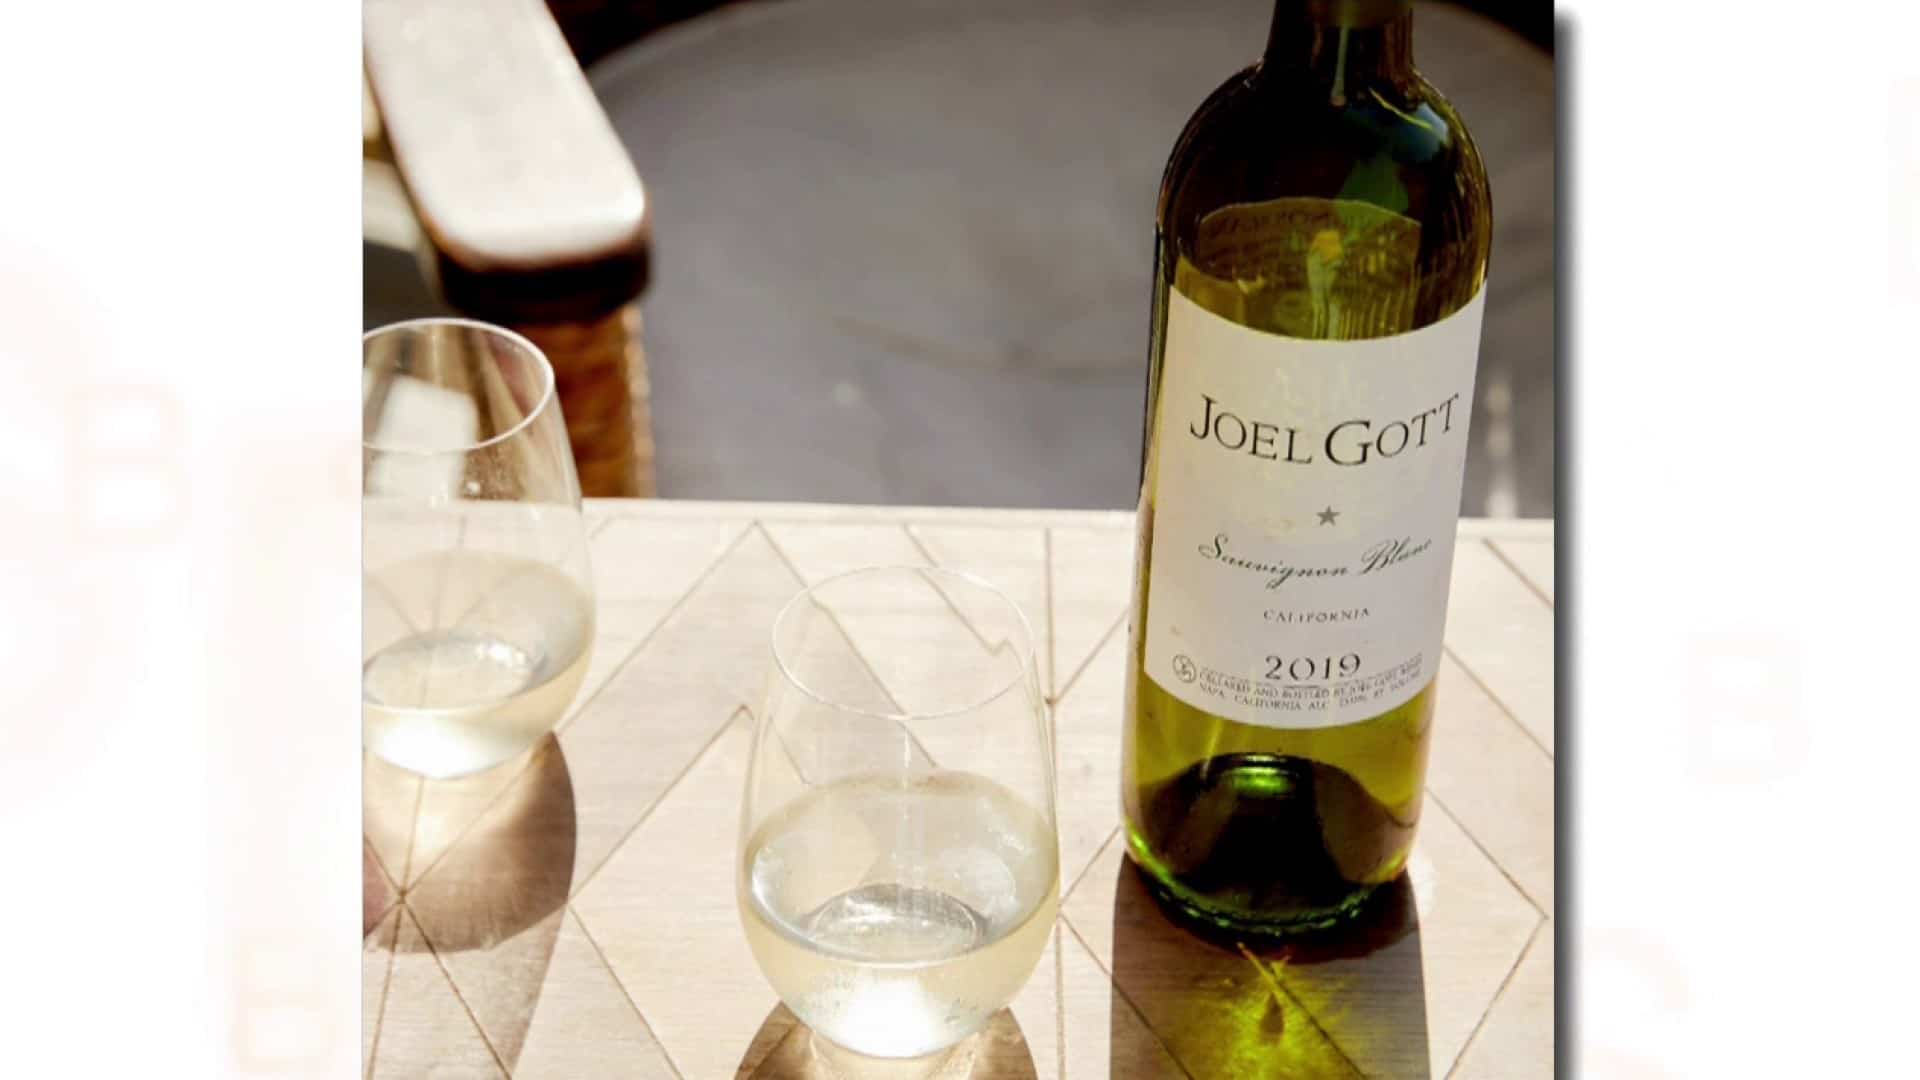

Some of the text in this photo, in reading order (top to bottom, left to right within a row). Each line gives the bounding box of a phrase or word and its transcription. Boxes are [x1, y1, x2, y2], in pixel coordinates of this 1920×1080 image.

[1190, 393, 1459, 466] JOEL GOTT
[1198, 534, 1432, 589] Sauvignon Blanc
[1263, 606, 1370, 624] CALIFORNIA
[1264, 653, 1361, 682] 2019
